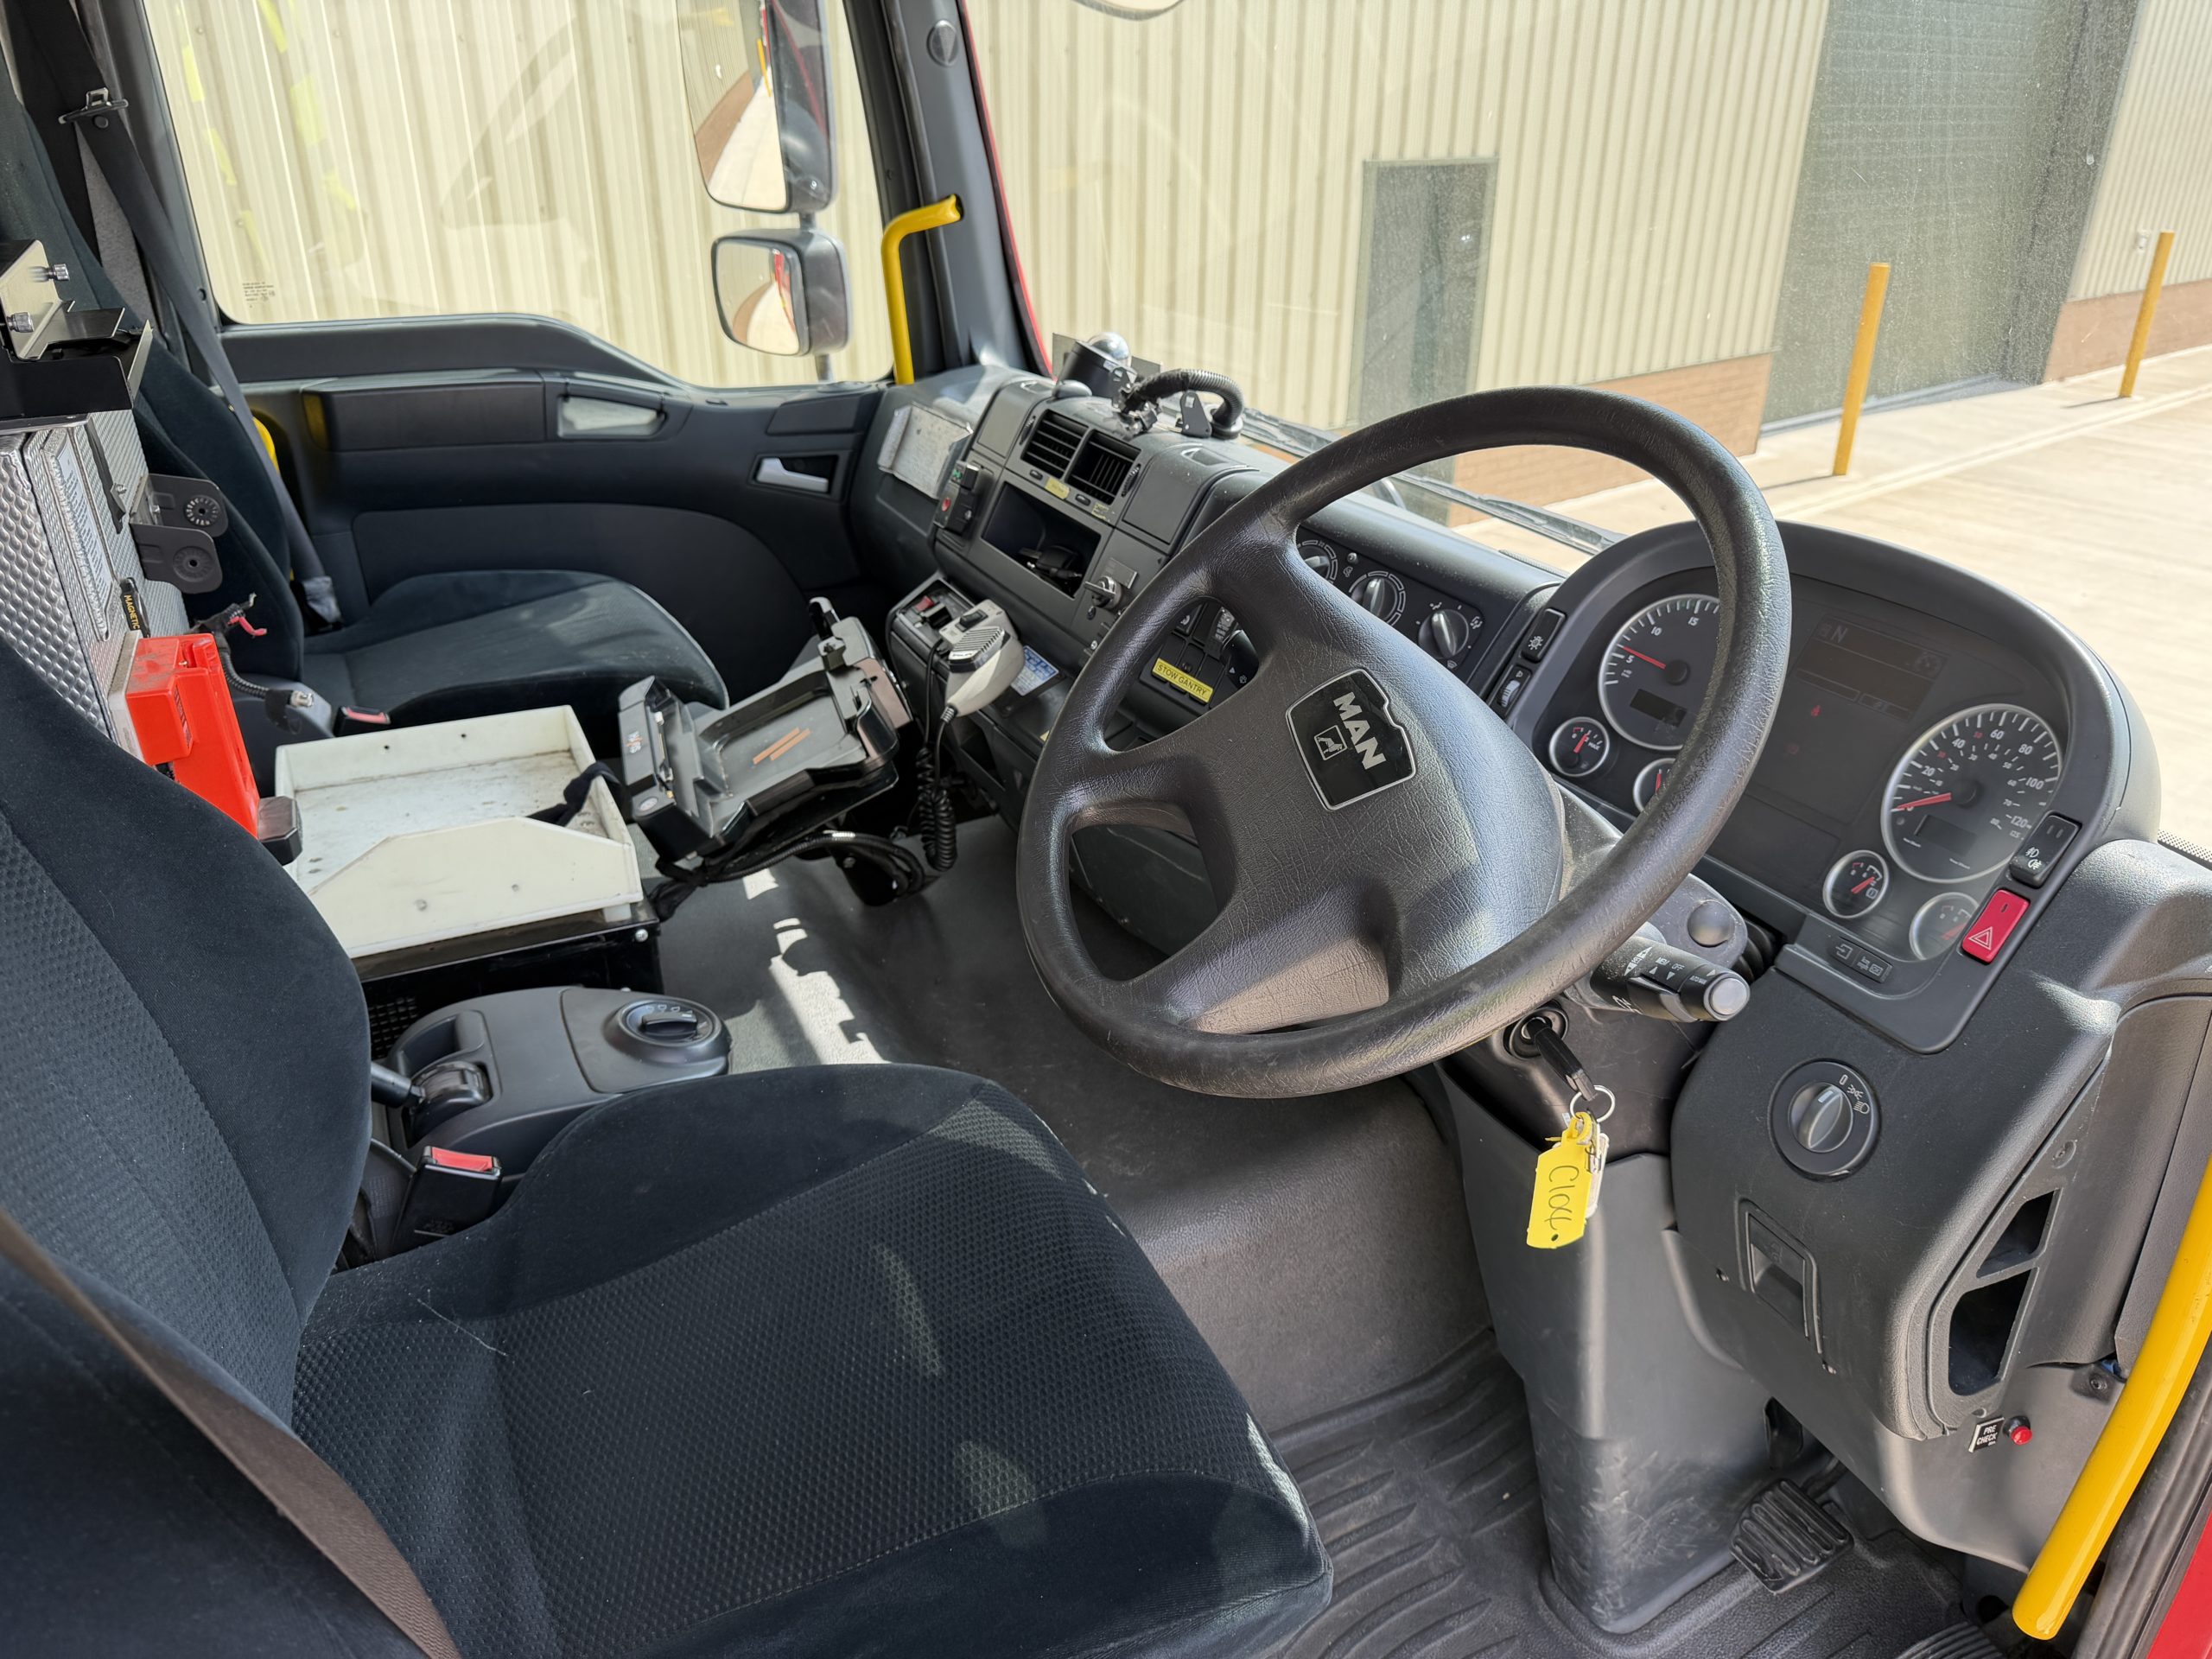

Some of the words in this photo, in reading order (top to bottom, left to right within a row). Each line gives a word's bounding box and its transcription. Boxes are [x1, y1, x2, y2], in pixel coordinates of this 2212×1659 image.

[124, 594, 141, 630] MAGNETIC
[1688, 616, 1700, 626] 15
[1651, 626, 1662, 636] 10
[1625, 655, 1635, 664] 5
[1157, 661, 1179, 681] STOW
[1178, 674, 1207, 696] GANTRY
[1332, 691, 1387, 770] MAN
[1990, 728, 2005, 740] 60
[1952, 738, 1966, 749] 40
[2018, 744, 2033, 755] 80
[1921, 766, 1936, 777] 20
[2025, 777, 2044, 790] 100
[2010, 815, 2029, 829] 120
[1983, 1424, 1997, 1435] PRE
[1976, 1432, 1998, 1446] CHECK
